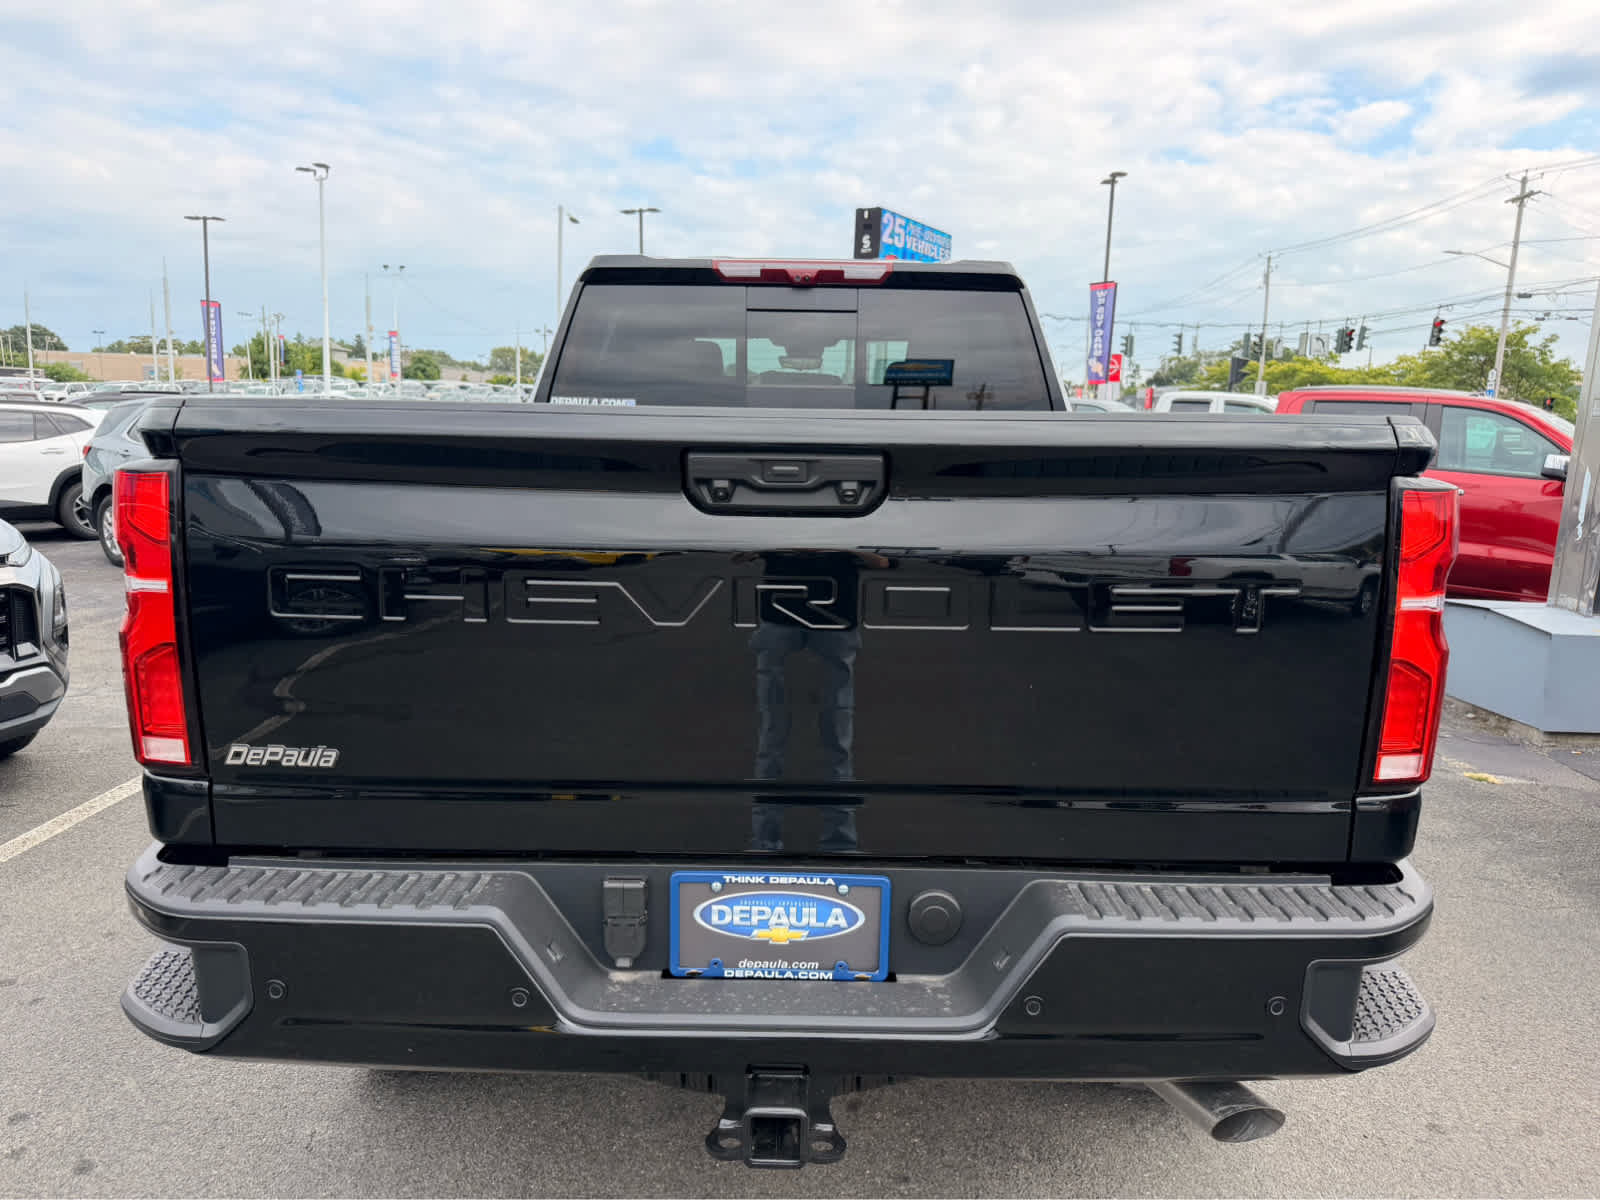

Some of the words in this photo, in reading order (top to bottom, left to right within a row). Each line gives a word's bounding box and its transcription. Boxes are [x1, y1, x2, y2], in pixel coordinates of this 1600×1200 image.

[881, 212, 905, 248] 25
[906, 235, 952, 262] VEHICLES
[267, 563, 1303, 636] CHEVROLET
[225, 743, 339, 768] DePaula
[723, 874, 766, 884] THINK
[769, 876, 836, 886] DEPAULA
[711, 904, 849, 928] DEPAULA
[723, 968, 832, 980] DEPAULA.COM
[738, 958, 819, 970] depaula.com
